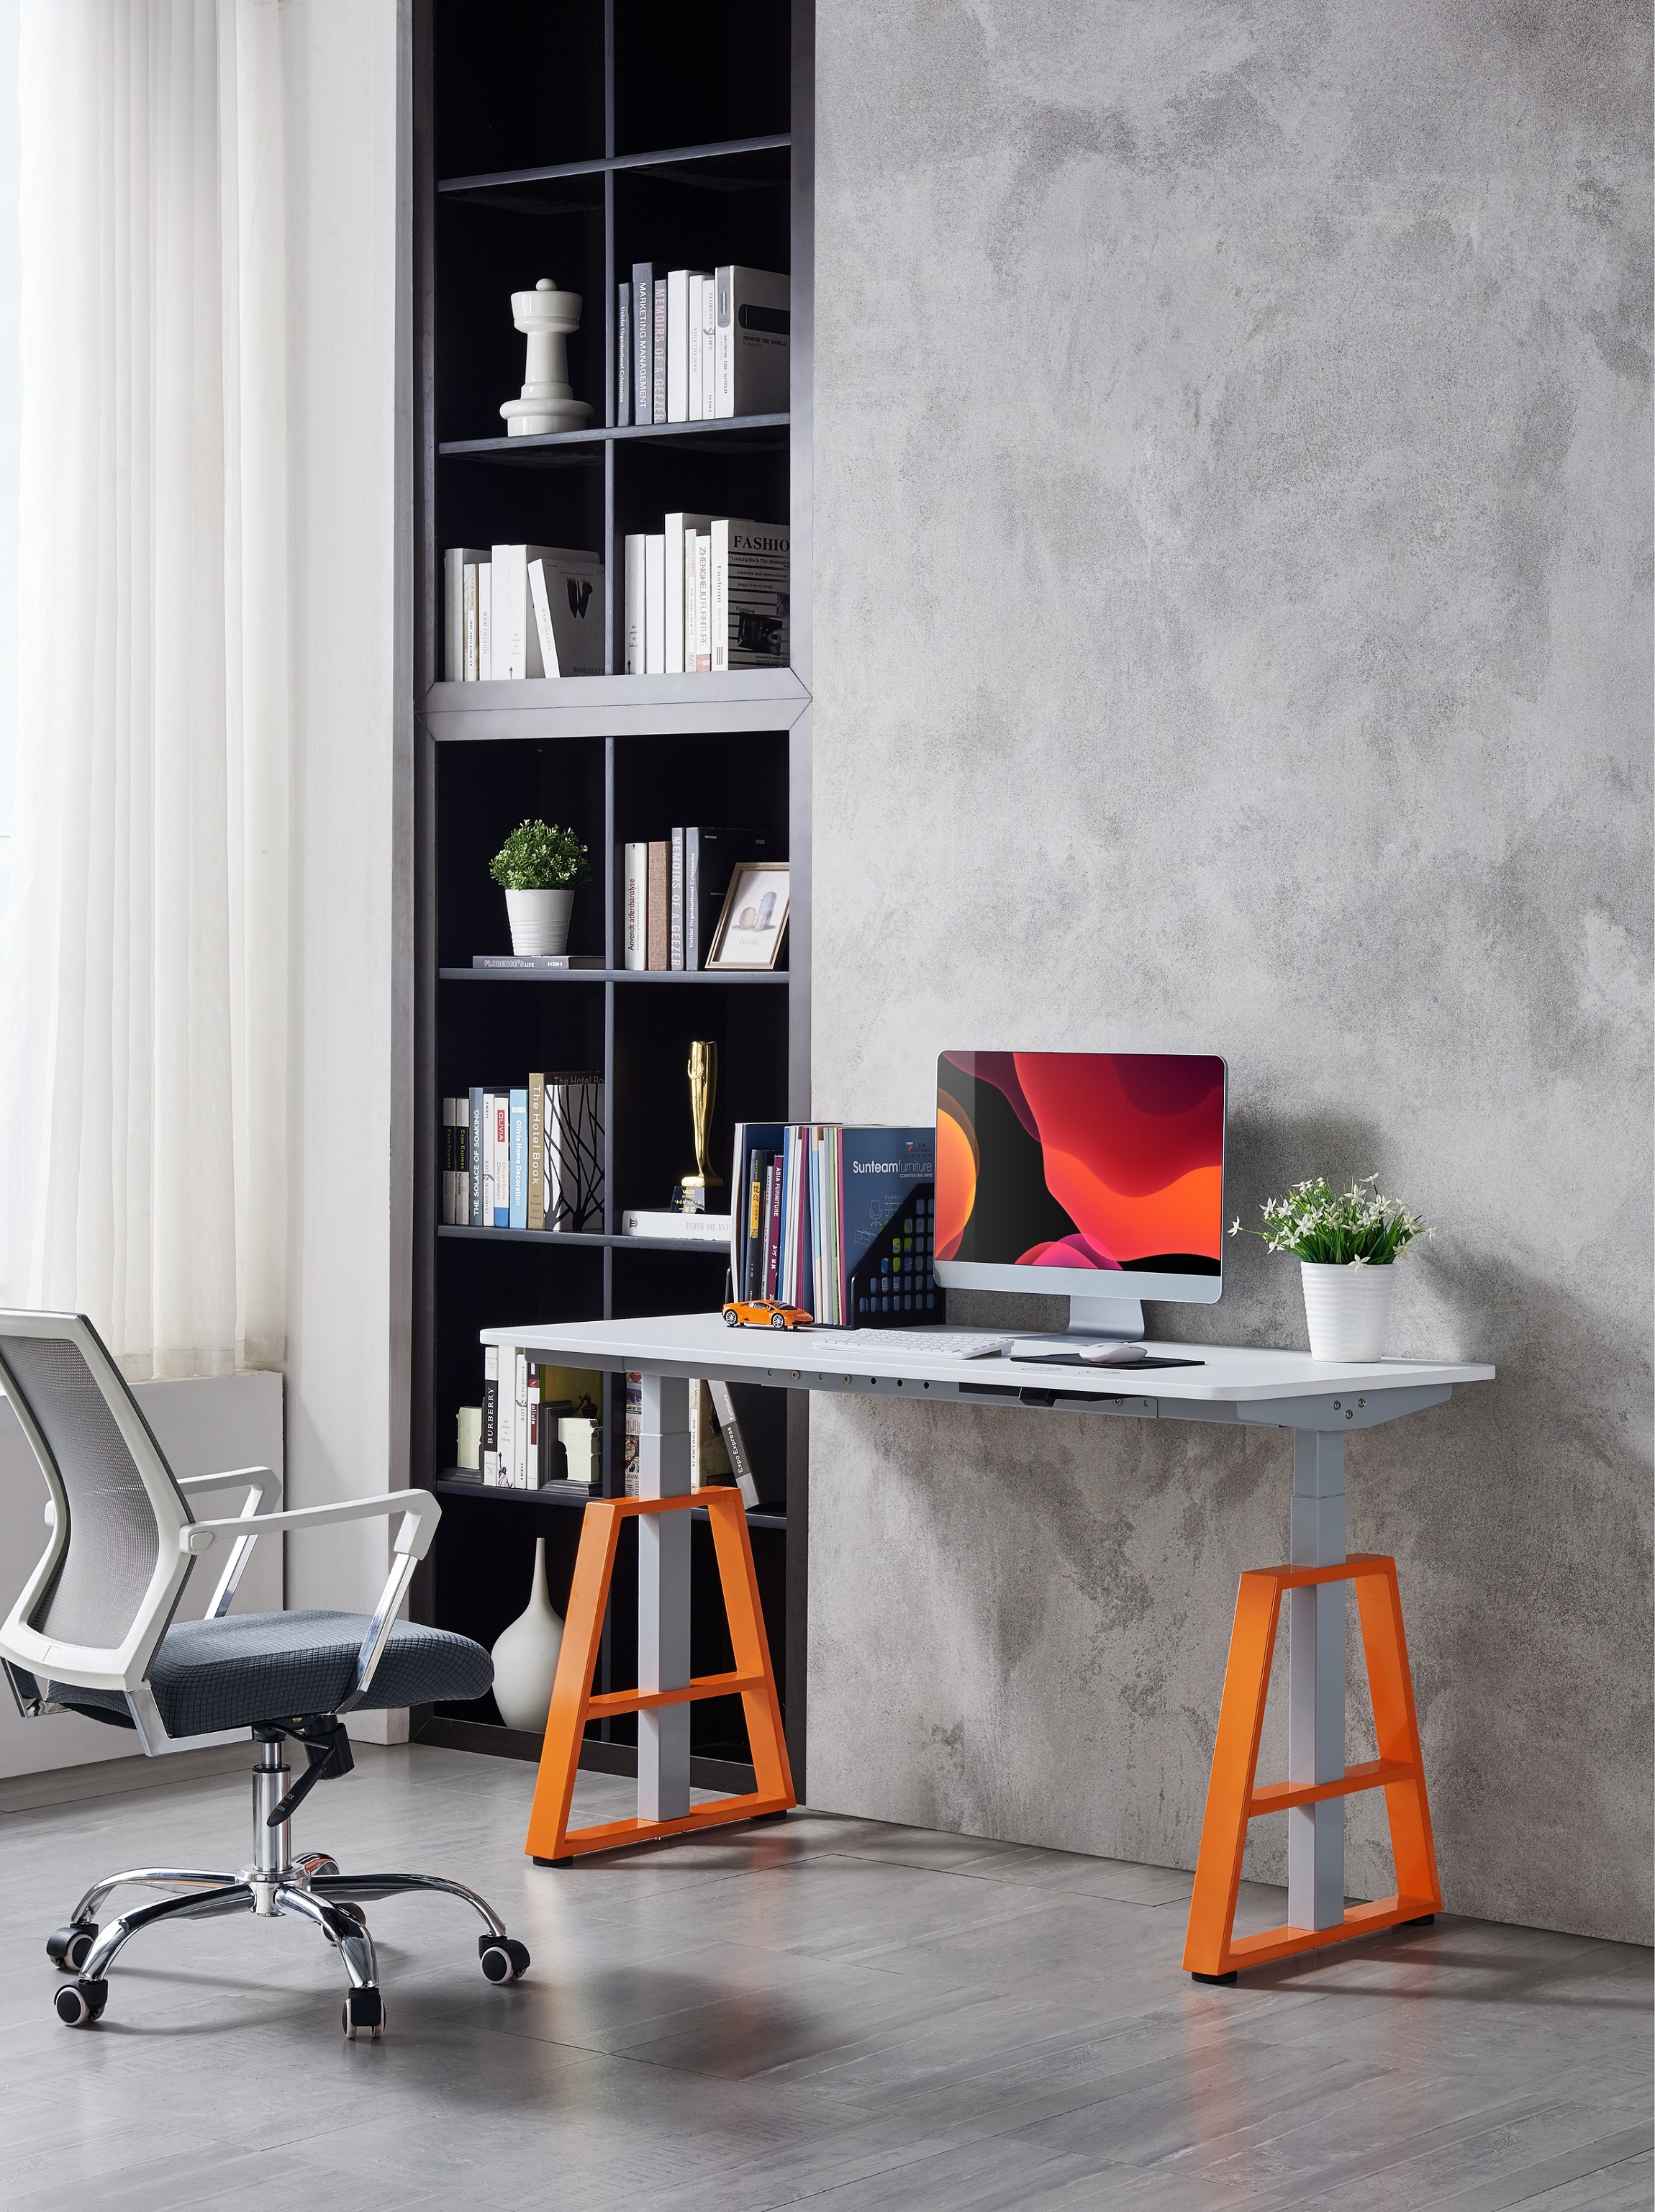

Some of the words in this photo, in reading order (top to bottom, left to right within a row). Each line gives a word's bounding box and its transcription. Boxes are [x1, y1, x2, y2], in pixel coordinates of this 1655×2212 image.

[655, 289, 665, 342] MEMOIRS
[655, 348, 663, 361] OF
[654, 379, 664, 420] GEEZER
[734, 535, 790, 552] FASHIO
[735, 605, 755, 615] Fashion
[470, 621, 473, 630] DO
[672, 894, 680, 908] OF
[671, 925, 680, 966] GEEZER
[474, 1151, 479, 1161] OF
[753, 1184, 760, 1202] 梵高
[686, 1222, 704, 1230] BARDI
[724, 1395, 733, 1420] Furniture
[692, 1420, 696, 1429] DO
[727, 1427, 738, 1455] Express
